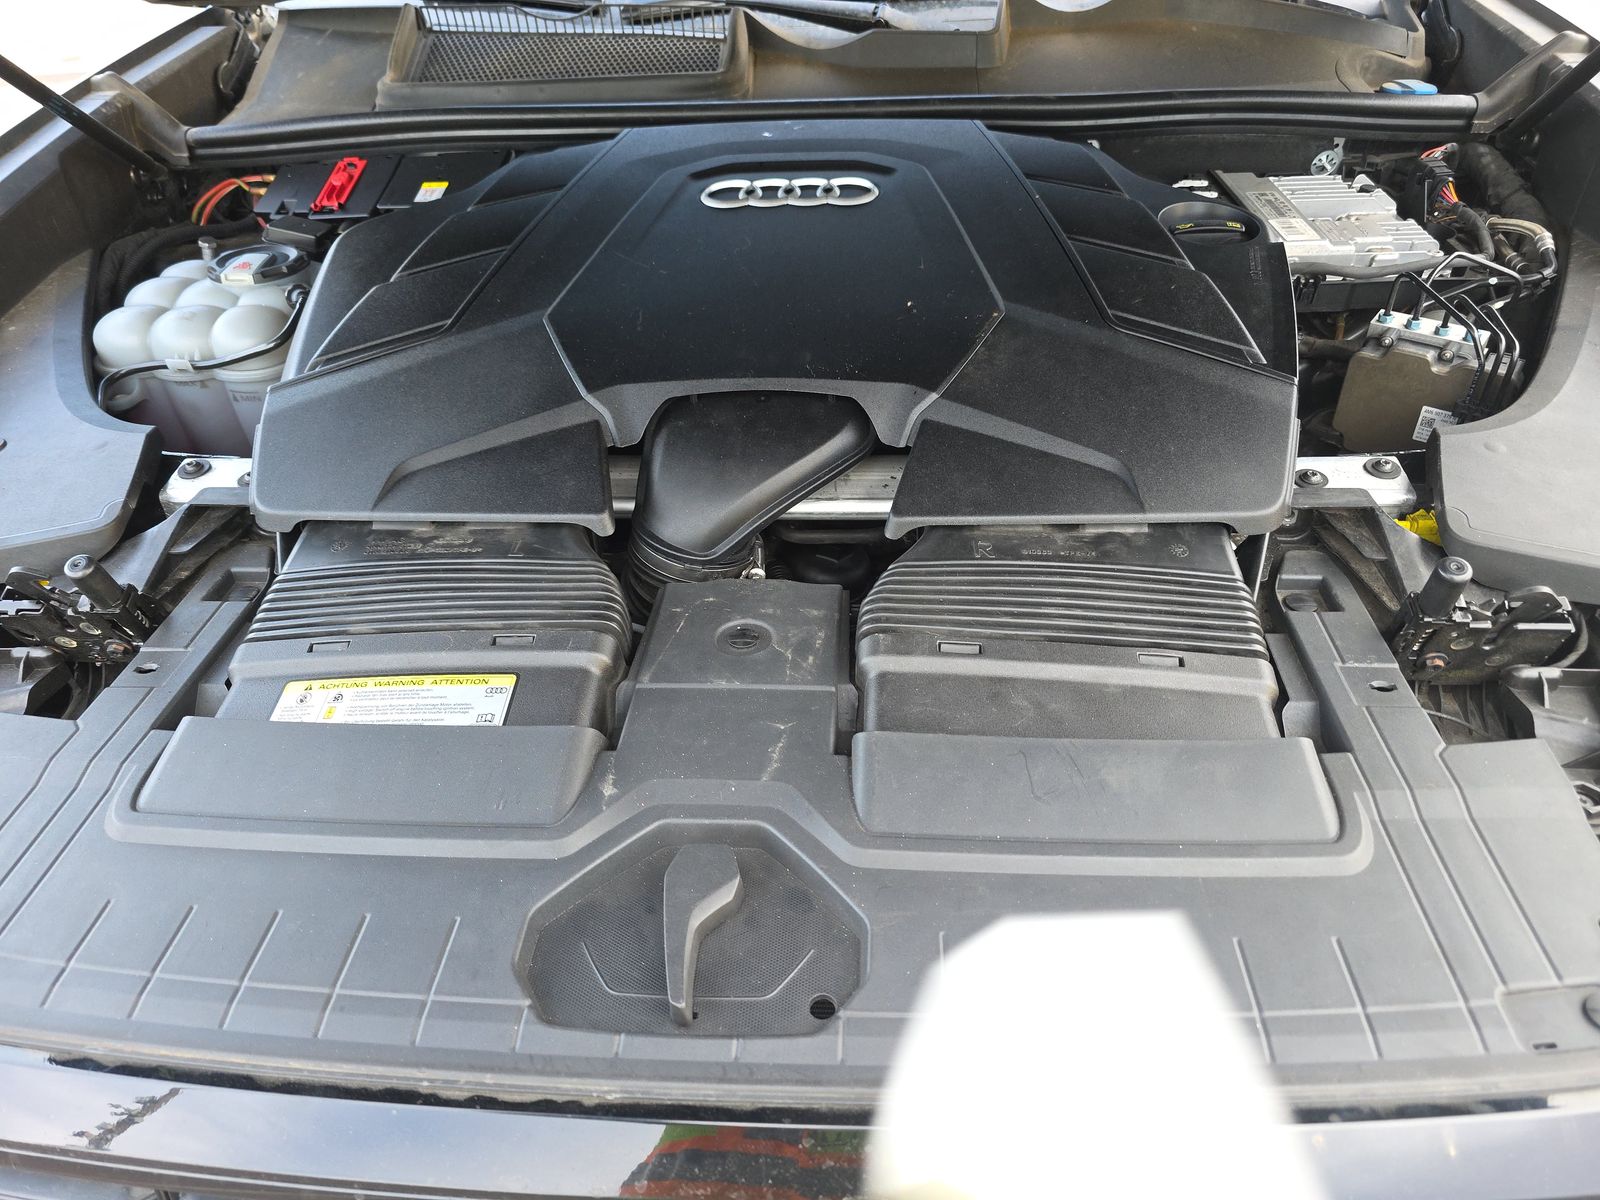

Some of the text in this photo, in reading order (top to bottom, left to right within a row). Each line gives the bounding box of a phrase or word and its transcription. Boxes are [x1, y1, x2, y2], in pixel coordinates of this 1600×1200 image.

[318, 678, 490, 690] ACHTUNG WARNING ATTENTION
